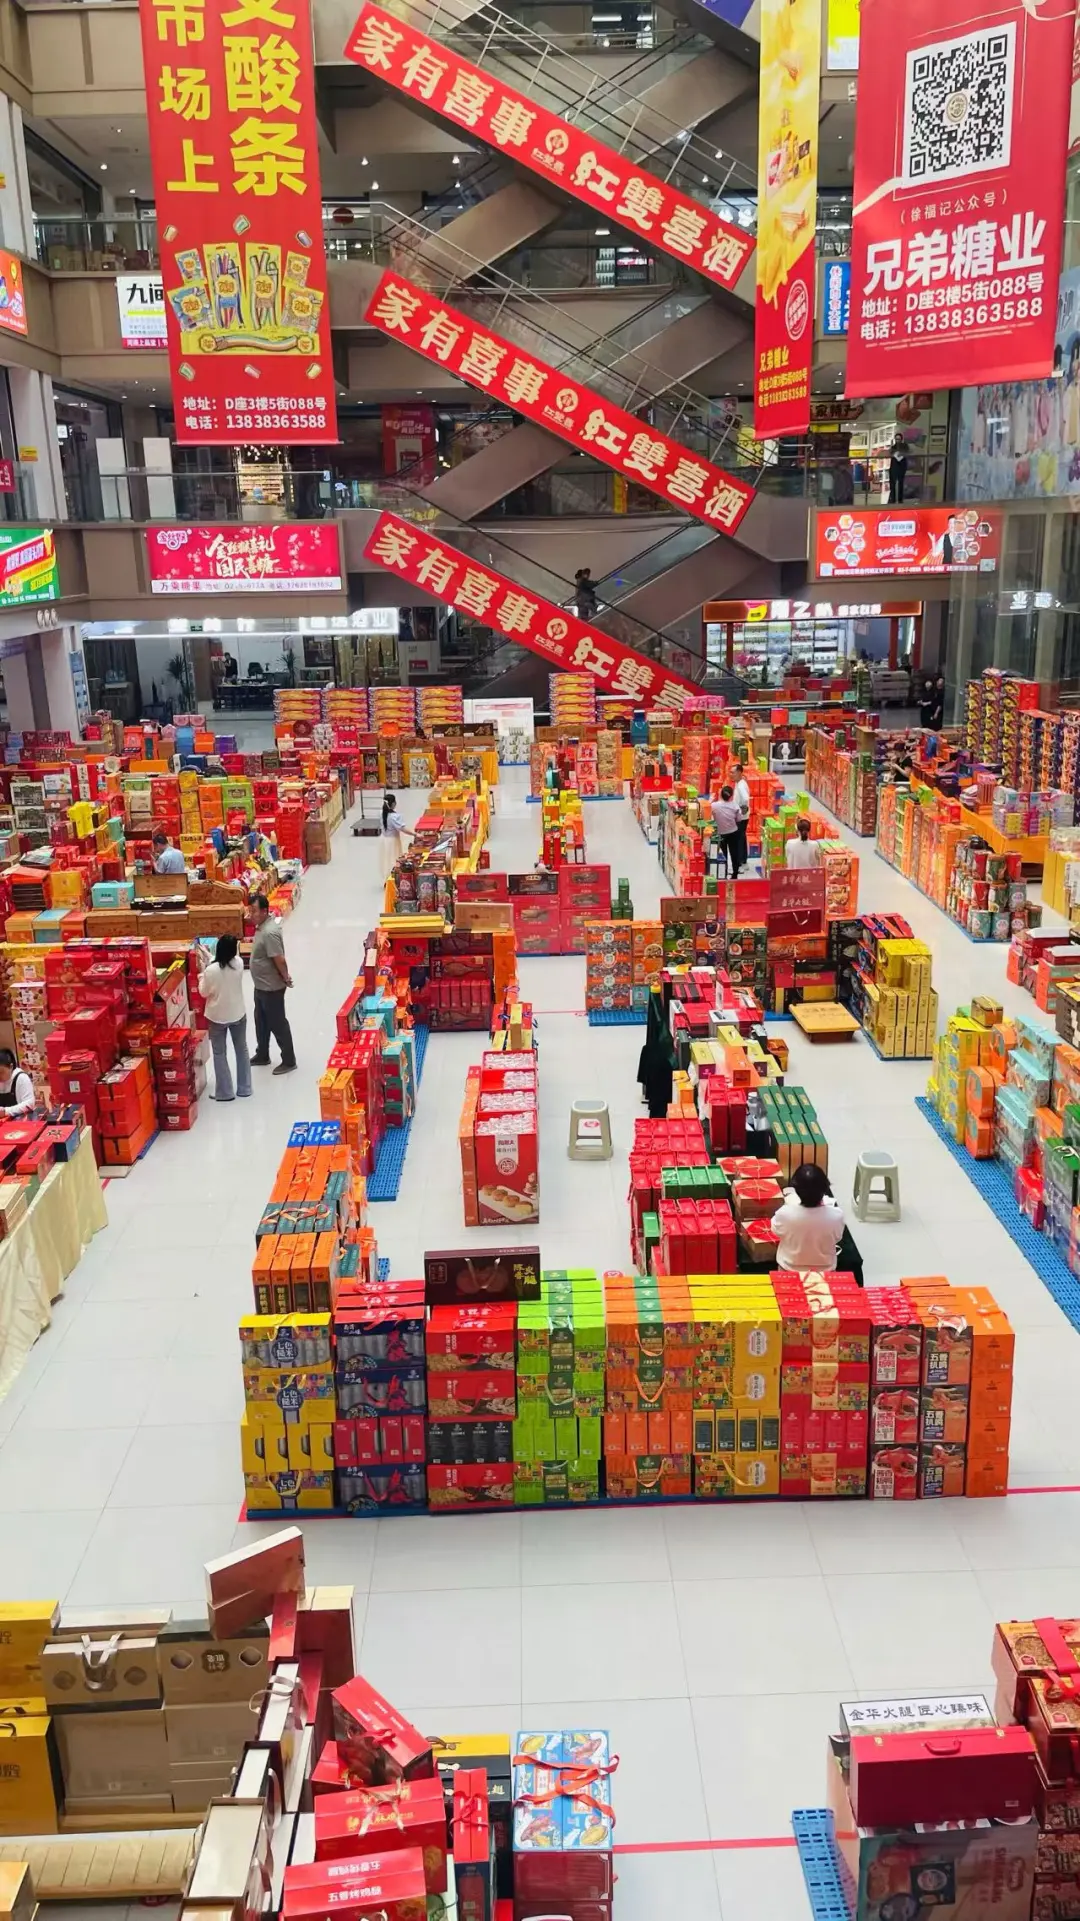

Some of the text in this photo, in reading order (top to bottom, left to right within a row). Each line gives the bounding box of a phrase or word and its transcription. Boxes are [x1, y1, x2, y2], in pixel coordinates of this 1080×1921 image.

[352, 15, 538, 149] 家有喜事
[862, 212, 1046, 295] 兄弟糖业
[373, 282, 549, 406] 家有喜事
[372, 522, 541, 635] 家有喜事
[849, 1705, 915, 1721] 金华火腿
